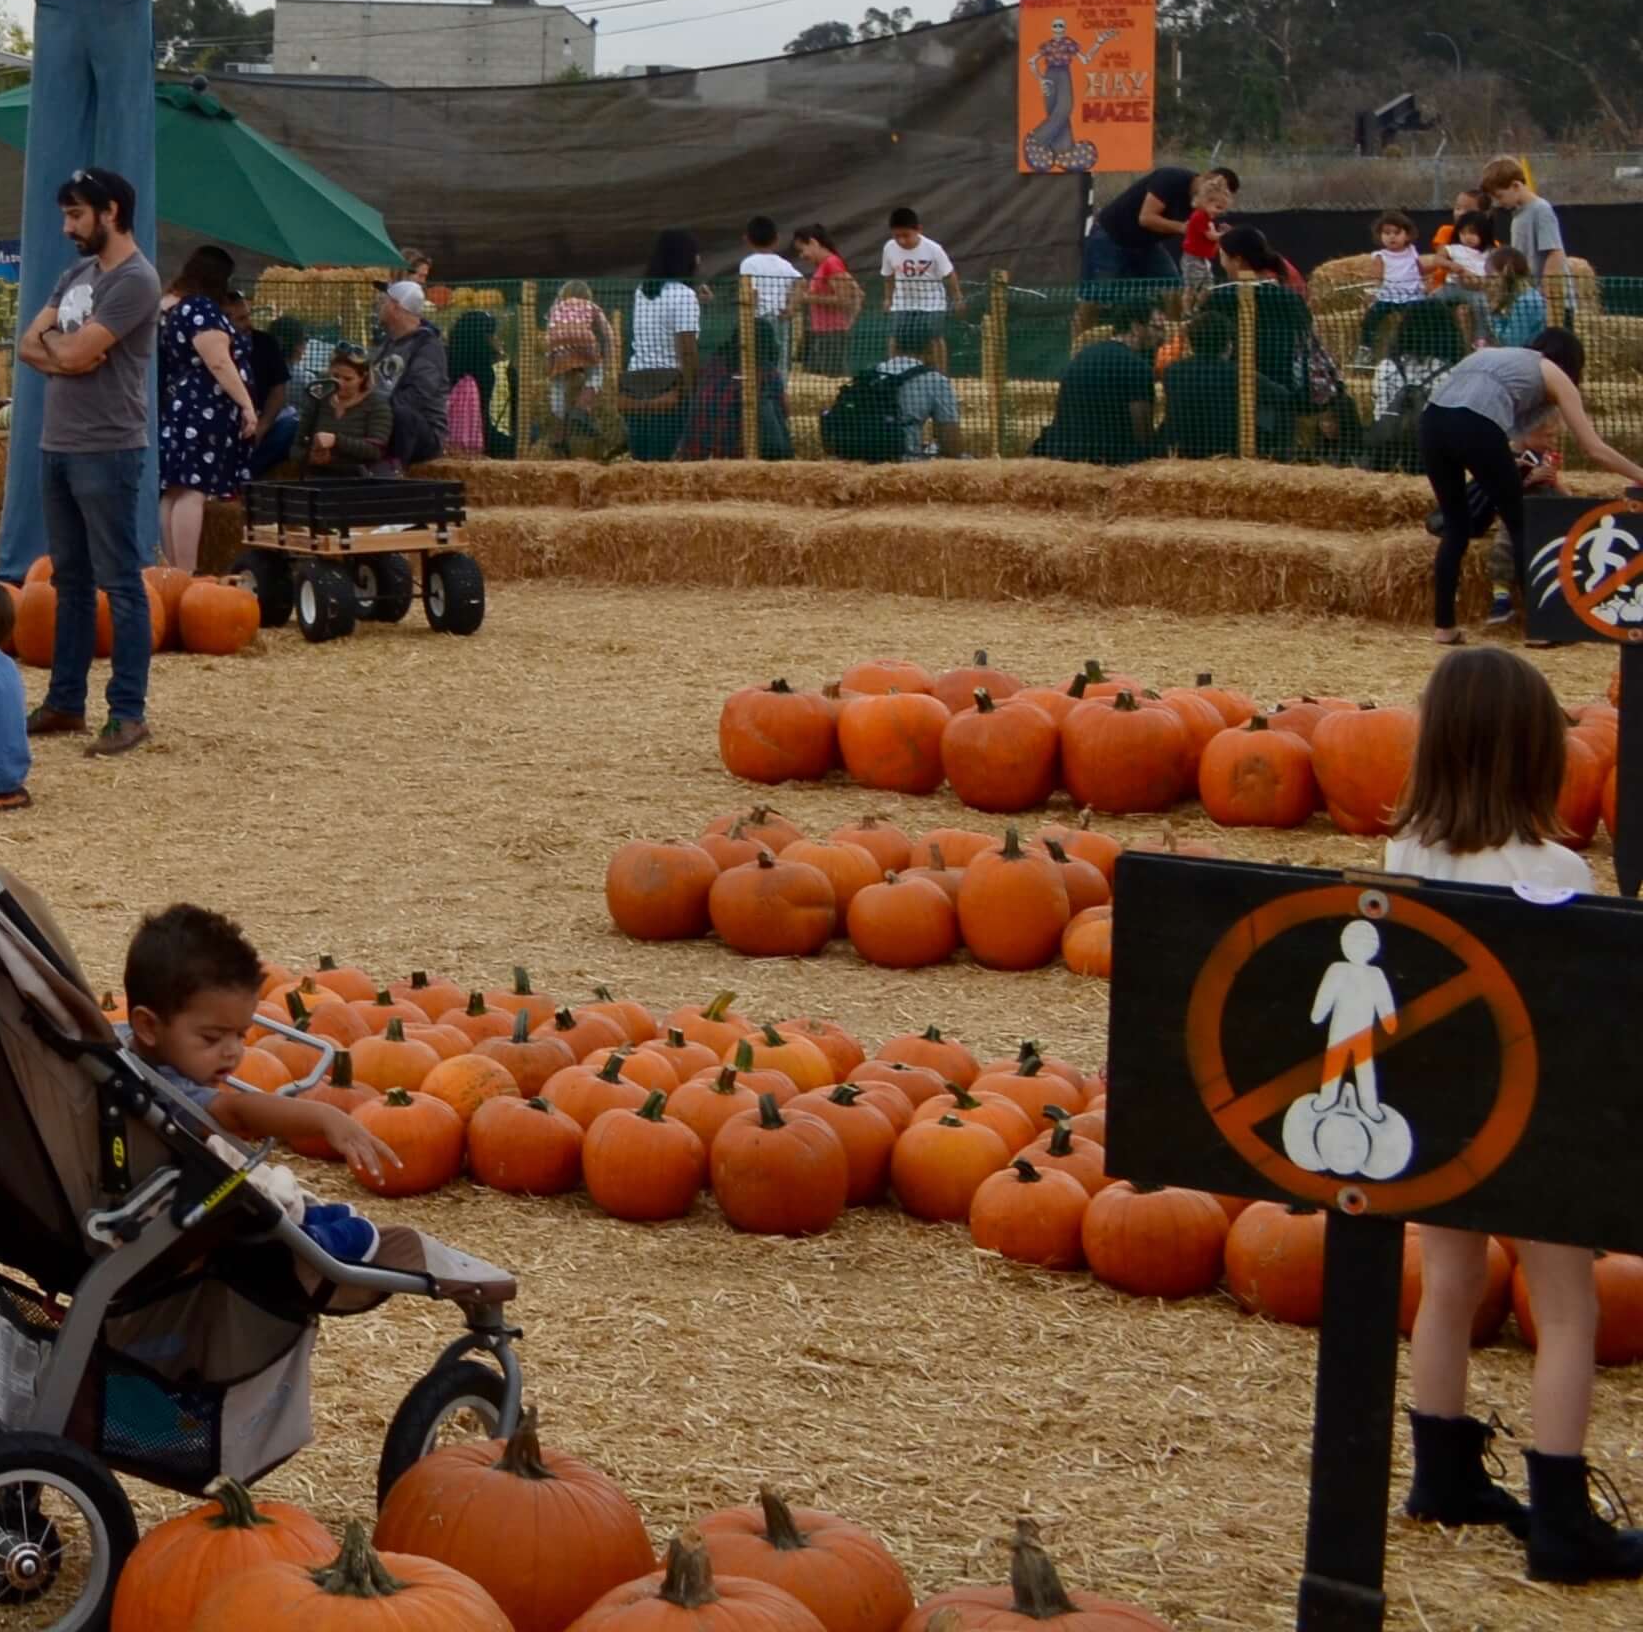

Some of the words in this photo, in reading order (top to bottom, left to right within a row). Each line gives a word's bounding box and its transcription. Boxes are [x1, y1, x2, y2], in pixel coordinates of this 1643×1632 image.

[1084, 71, 1148, 97] HAY
[1082, 101, 1151, 123] MAZE
[903, 259, 932, 277] 67
